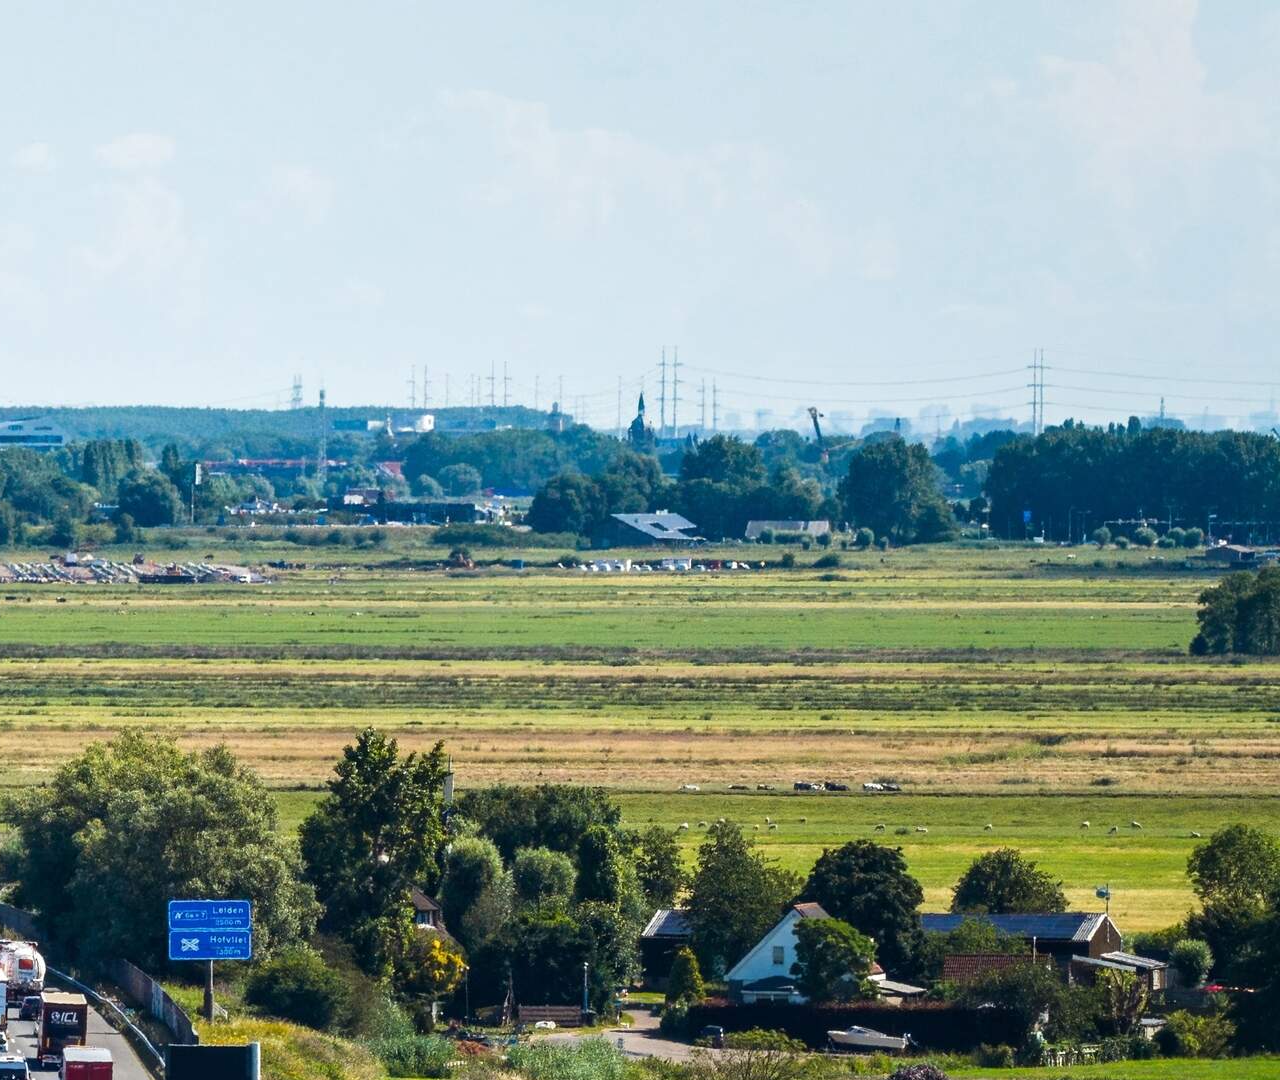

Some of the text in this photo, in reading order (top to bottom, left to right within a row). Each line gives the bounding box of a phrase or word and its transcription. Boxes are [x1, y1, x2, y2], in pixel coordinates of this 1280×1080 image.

[213, 906, 243, 914] Leiden
[209, 935, 247, 944] Hofvliet
[61, 1011, 79, 1023] ICL
